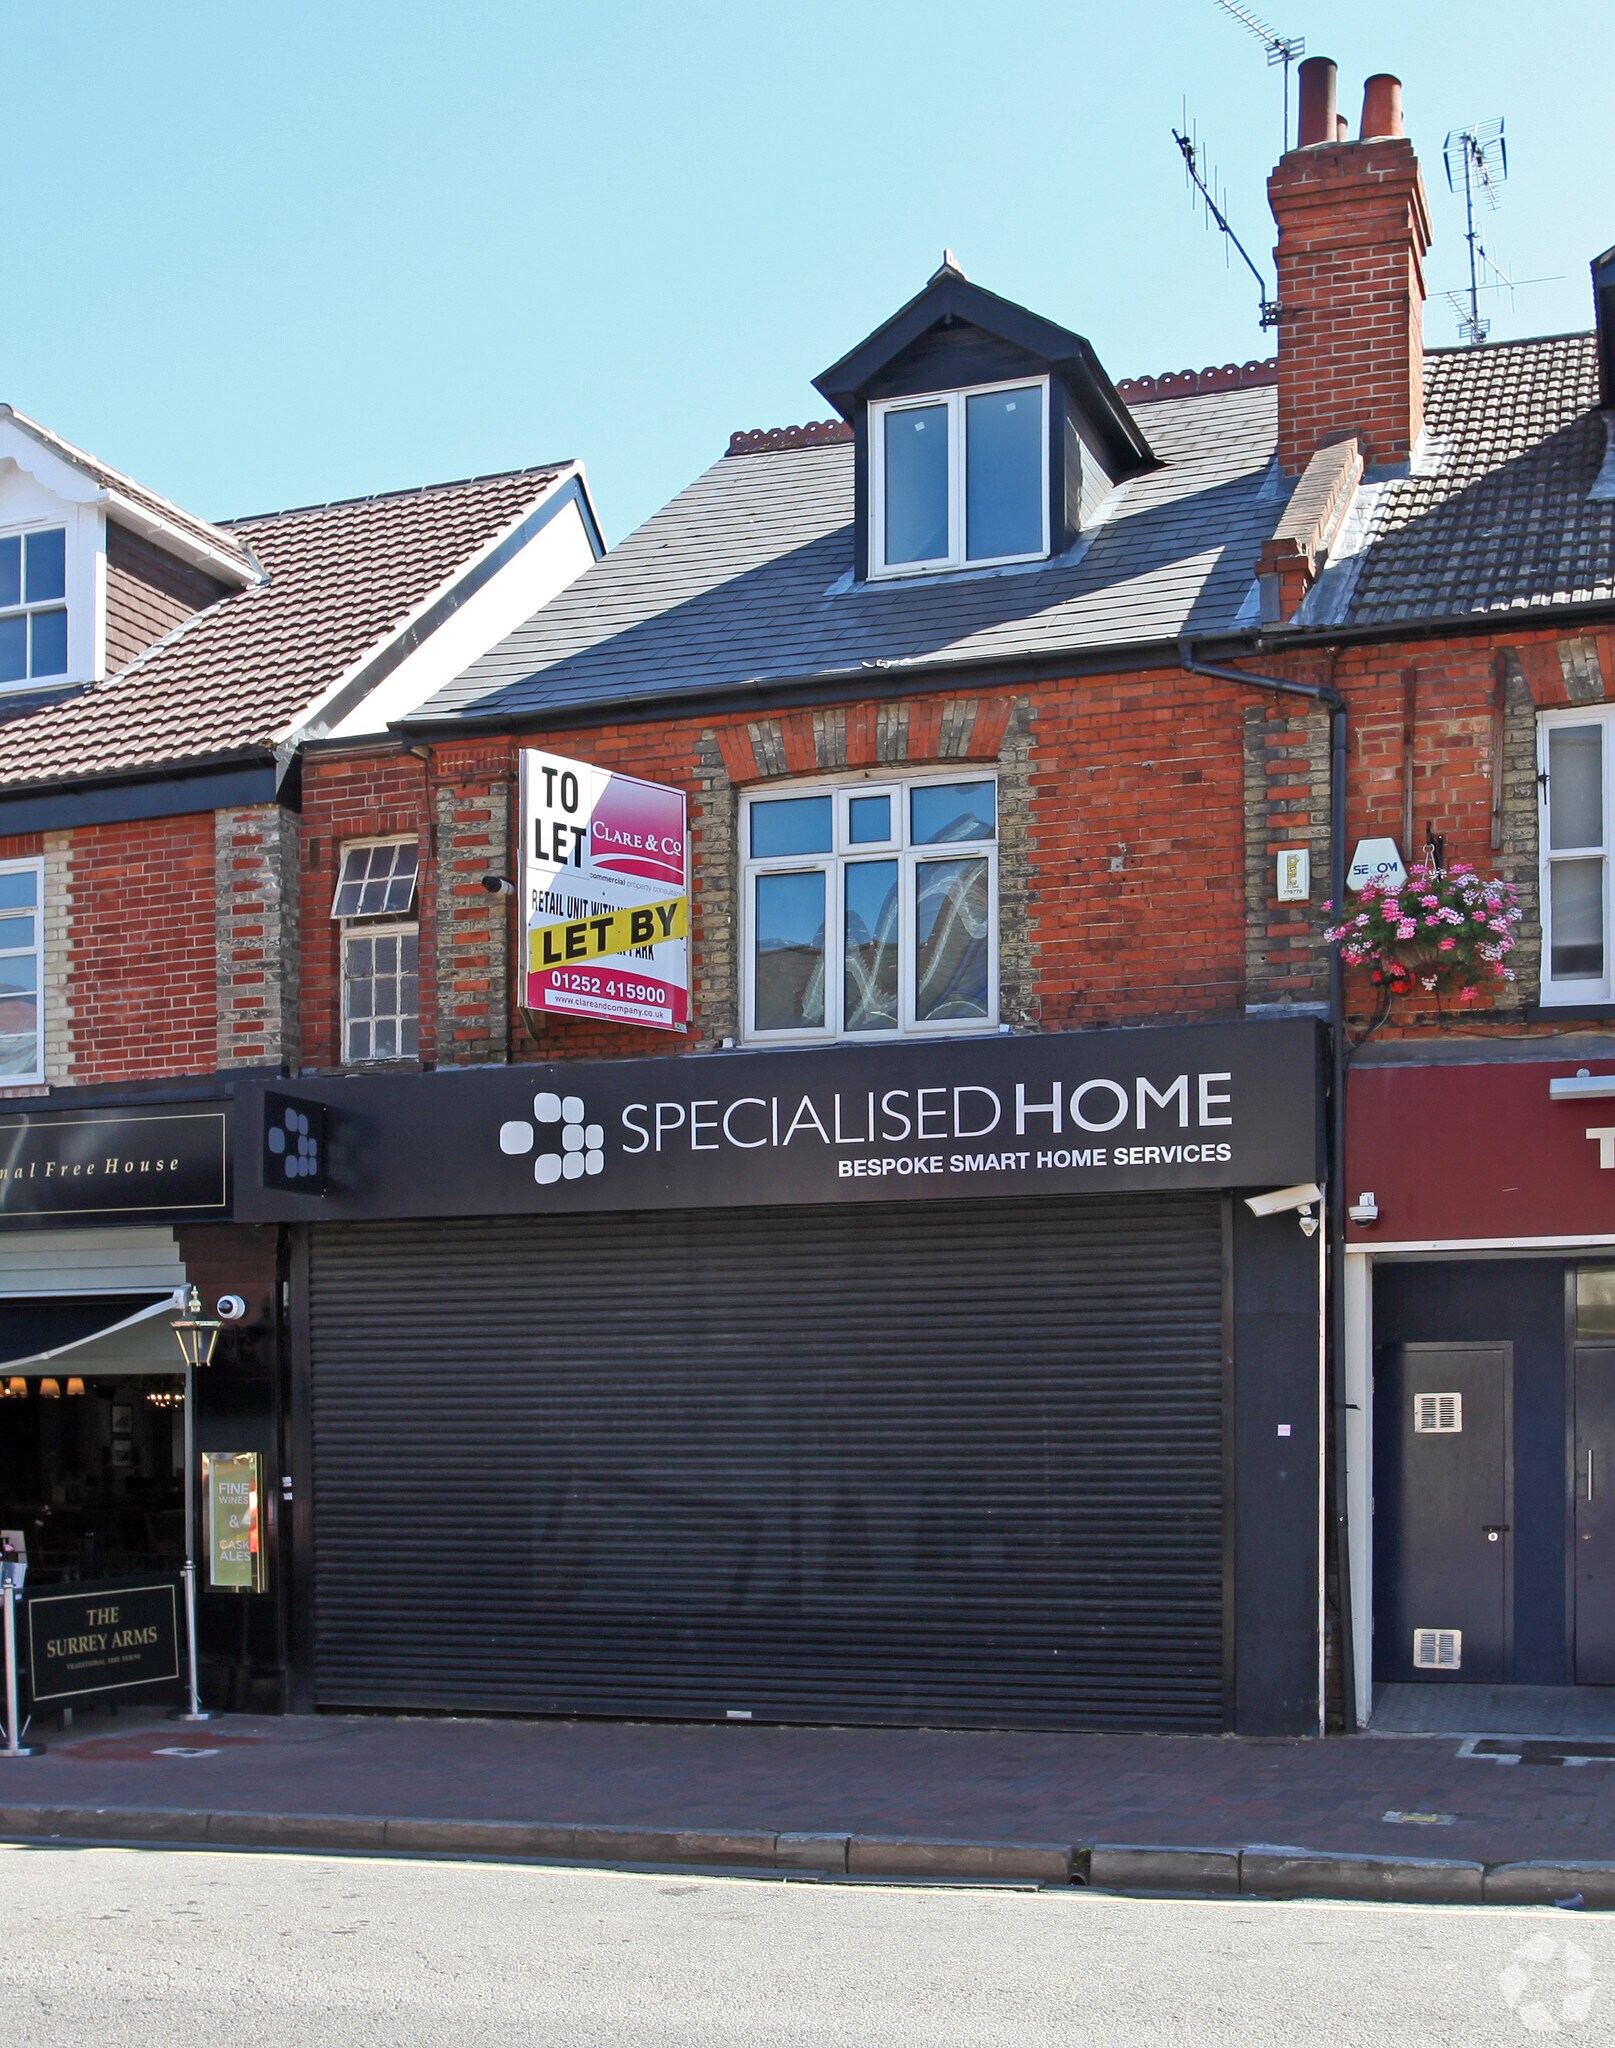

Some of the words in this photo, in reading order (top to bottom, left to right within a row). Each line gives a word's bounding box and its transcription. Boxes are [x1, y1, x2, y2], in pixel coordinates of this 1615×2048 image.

[541, 766, 579, 814] TO
[534, 818, 587, 868] LET
[592, 820, 643, 849] CLARE
[645, 834, 659, 852] &
[589, 872, 626, 886] commercial
[627, 881, 652, 892] property
[531, 889, 564, 917] RETAIL
[567, 896, 589, 920] UNIT
[543, 917, 614, 965] LET
[631, 903, 678, 944] BY
[551, 970, 601, 993] 01252
[605, 980, 666, 1004] 415900
[555, 995, 664, 1018] www.clareandcompany.co.uk
[45, 1161, 95, 1178] Free
[104, 1158, 179, 1174] House
[838, 1156, 944, 1178] BESPOKE
[949, 1151, 1031, 1172] SMART
[1036, 1148, 1107, 1169] HOME
[1113, 1143, 1232, 1166] SERVICES
[219, 1482, 249, 1495] FINE
[219, 1496, 249, 1504] WINES
[229, 1514, 240, 1528] &
[219, 1540, 250, 1549] CASK
[220, 1551, 251, 1561] ALES
[86, 1606, 120, 1626] THE
[47, 1633, 108, 1658] SURREY
[111, 1626, 158, 1649] ARMS
